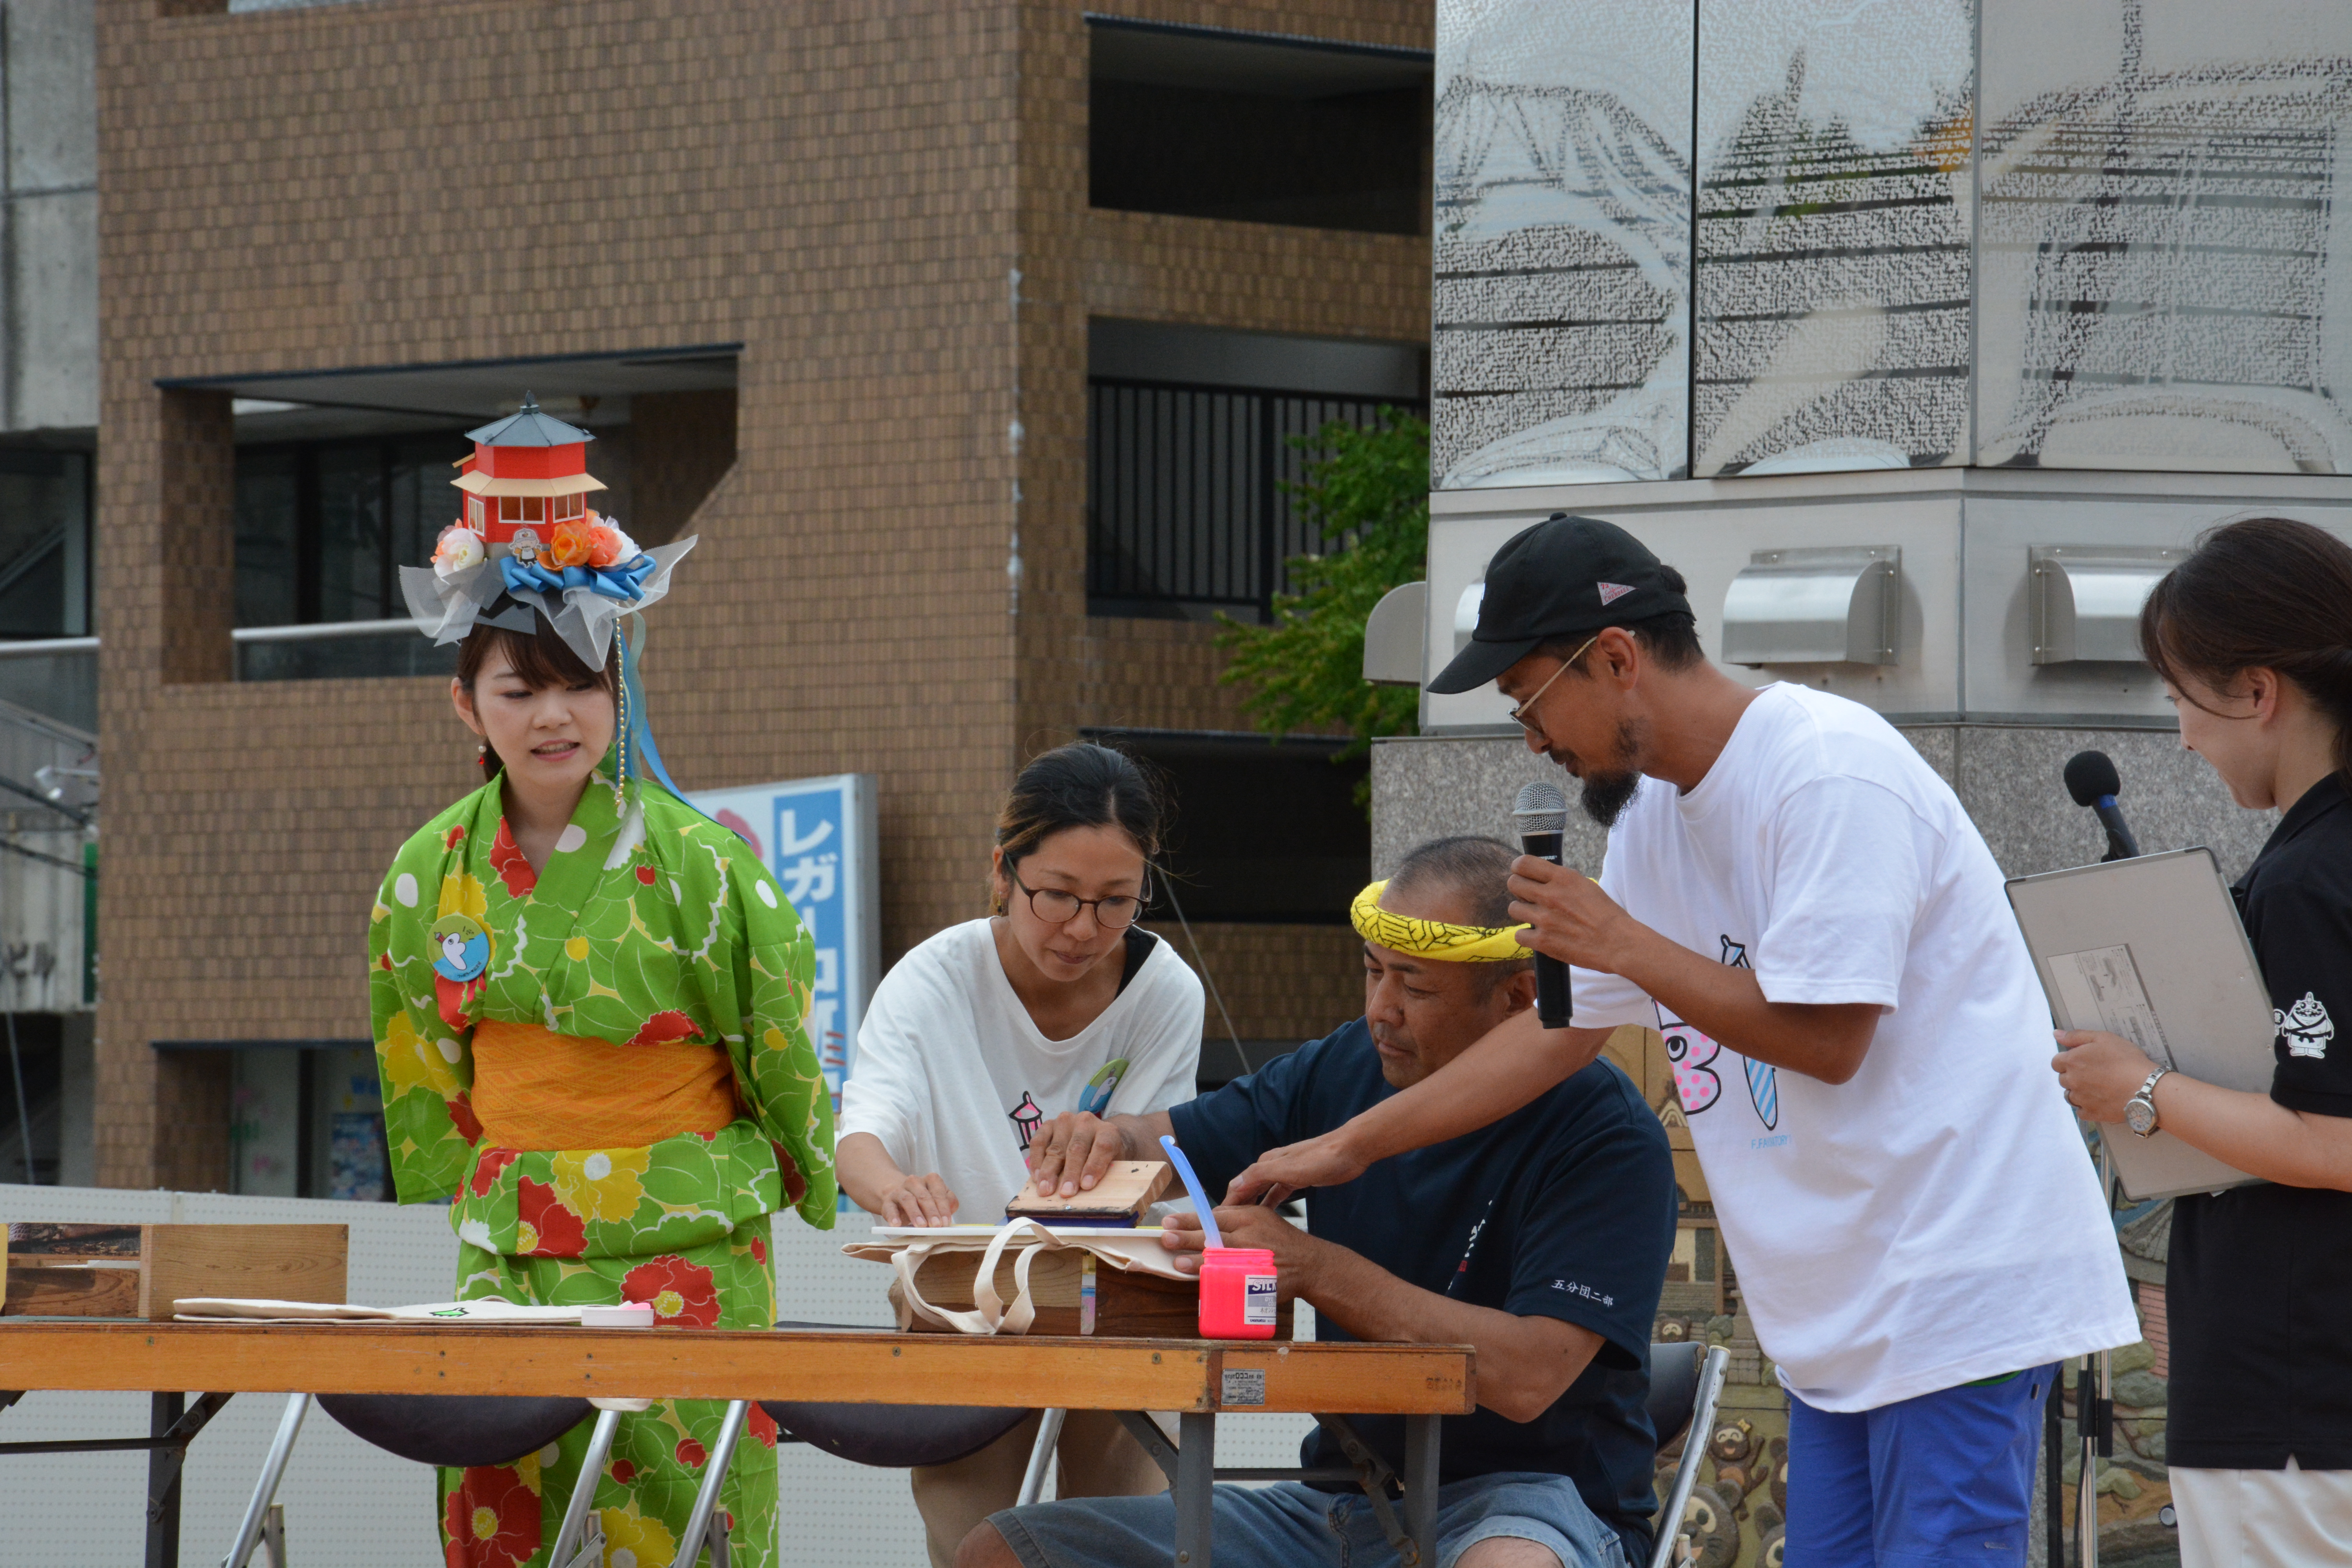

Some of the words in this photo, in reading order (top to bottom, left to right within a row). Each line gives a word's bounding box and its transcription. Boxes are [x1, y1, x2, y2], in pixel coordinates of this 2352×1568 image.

[1604, 586, 1630, 603] CHEROKEE
[1551, 1279, 1613, 1308] 五分団二部
